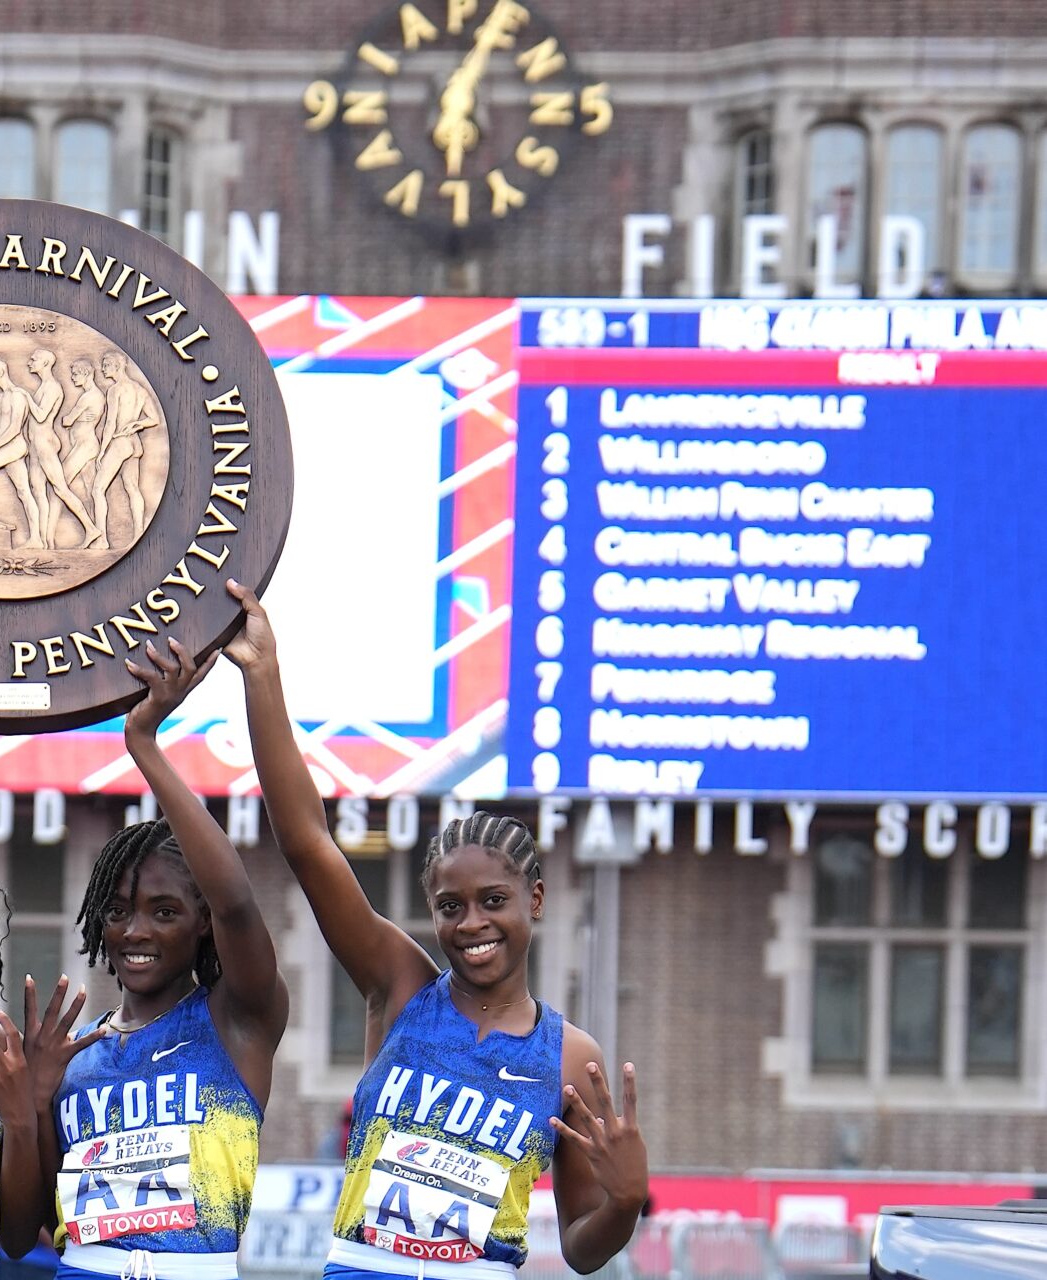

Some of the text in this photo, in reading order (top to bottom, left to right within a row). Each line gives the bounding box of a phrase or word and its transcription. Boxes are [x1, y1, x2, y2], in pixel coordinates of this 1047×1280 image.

[304, 80, 338, 131] 9
[580, 82, 614, 135] 5
[622, 214, 926, 299] FIELD
[22, 320, 57, 333] 1895
[545, 387, 567, 426] 1
[542, 433, 569, 474] 2
[540, 478, 568, 520] 3
[10, 384, 251, 678] PENNSYLVANIA
[537, 524, 567, 565] 4
[537, 570, 565, 612] 5
[535, 615, 564, 657] 6
[535, 661, 563, 701] 7
[533, 707, 561, 749] 8
[532, 752, 560, 794] 9
[538, 796, 823, 855] FAMILY
[60, 1073, 203, 1144] HYDEL
[375, 1066, 533, 1161] HYDEL
[115, 1142, 173, 1160] RELAYS
[116, 1131, 159, 1148] PENN
[435, 1148, 483, 1171] PENN
[429, 1159, 491, 1187] RELAYS
[103, 1210, 184, 1234] TOYOTA
[398, 1240, 476, 1260] TOYOTA
